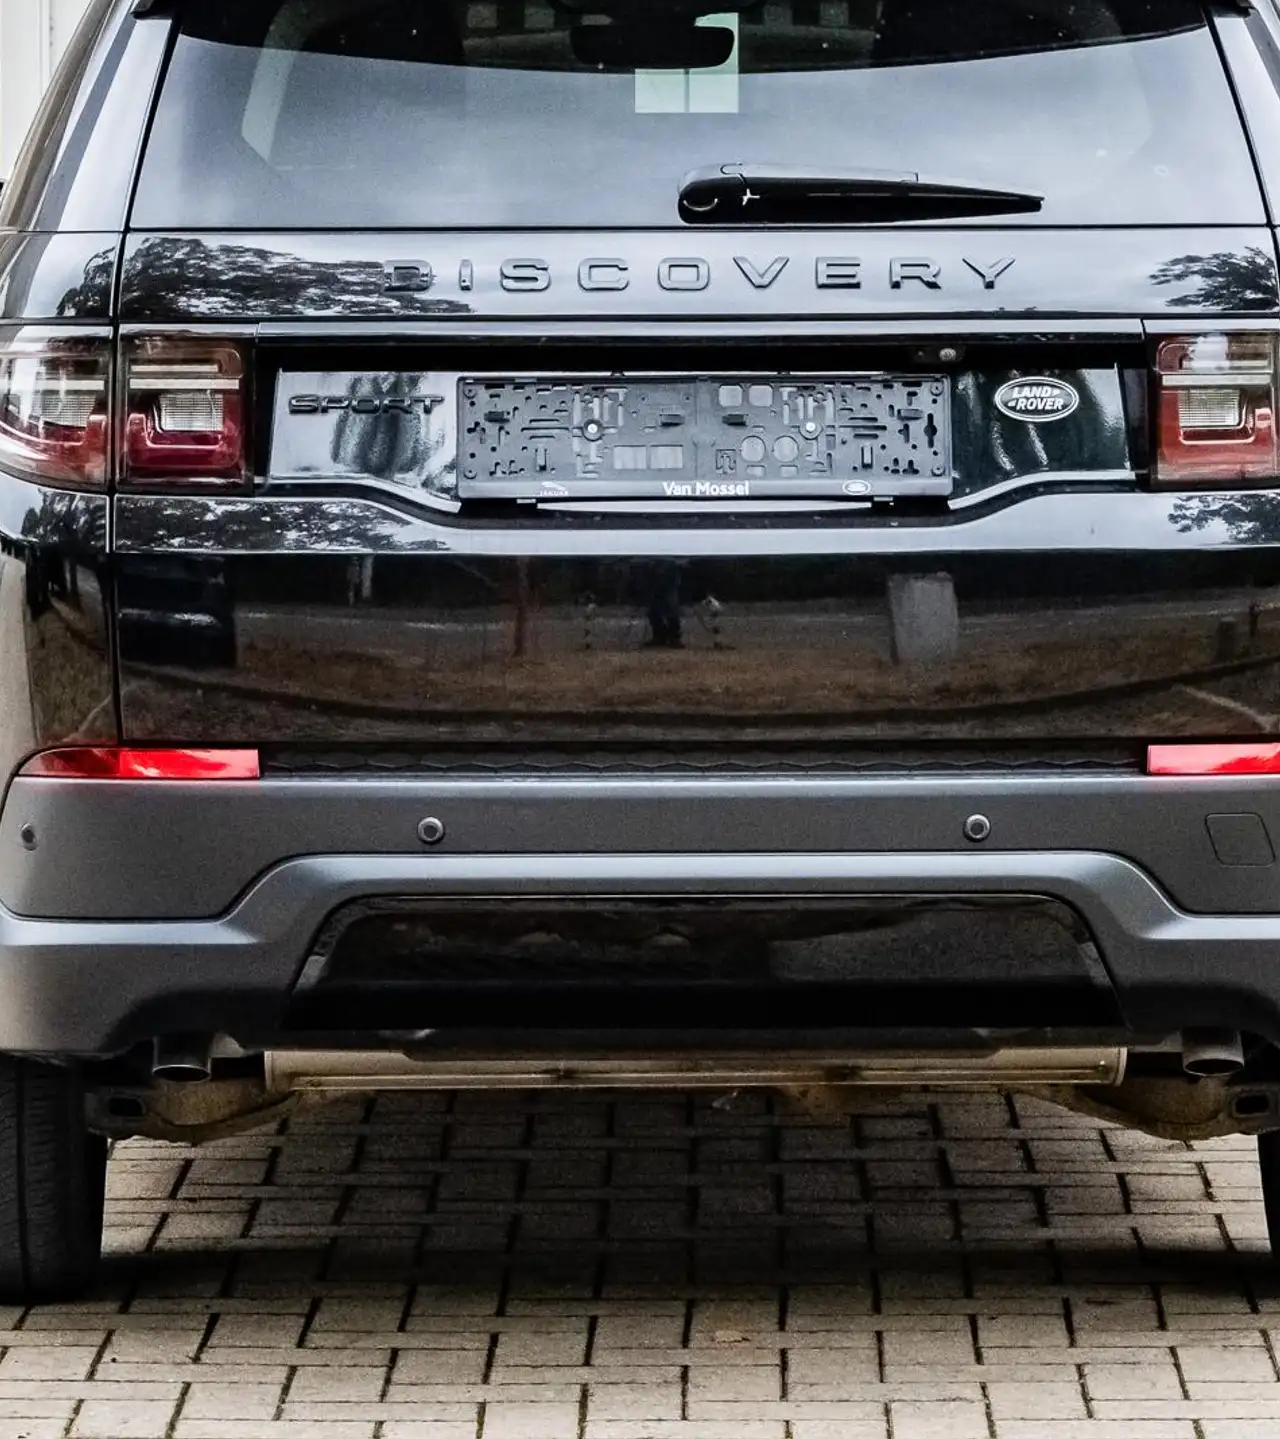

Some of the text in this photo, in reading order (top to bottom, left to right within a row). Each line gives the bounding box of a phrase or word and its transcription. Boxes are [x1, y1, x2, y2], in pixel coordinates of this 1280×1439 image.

[383, 256, 1016, 292] DISCOVERY
[1012, 385, 1052, 398] LAND
[289, 394, 445, 415] SPORT
[1016, 397, 1065, 410] ROVER
[661, 481, 750, 496] Van Mossel
